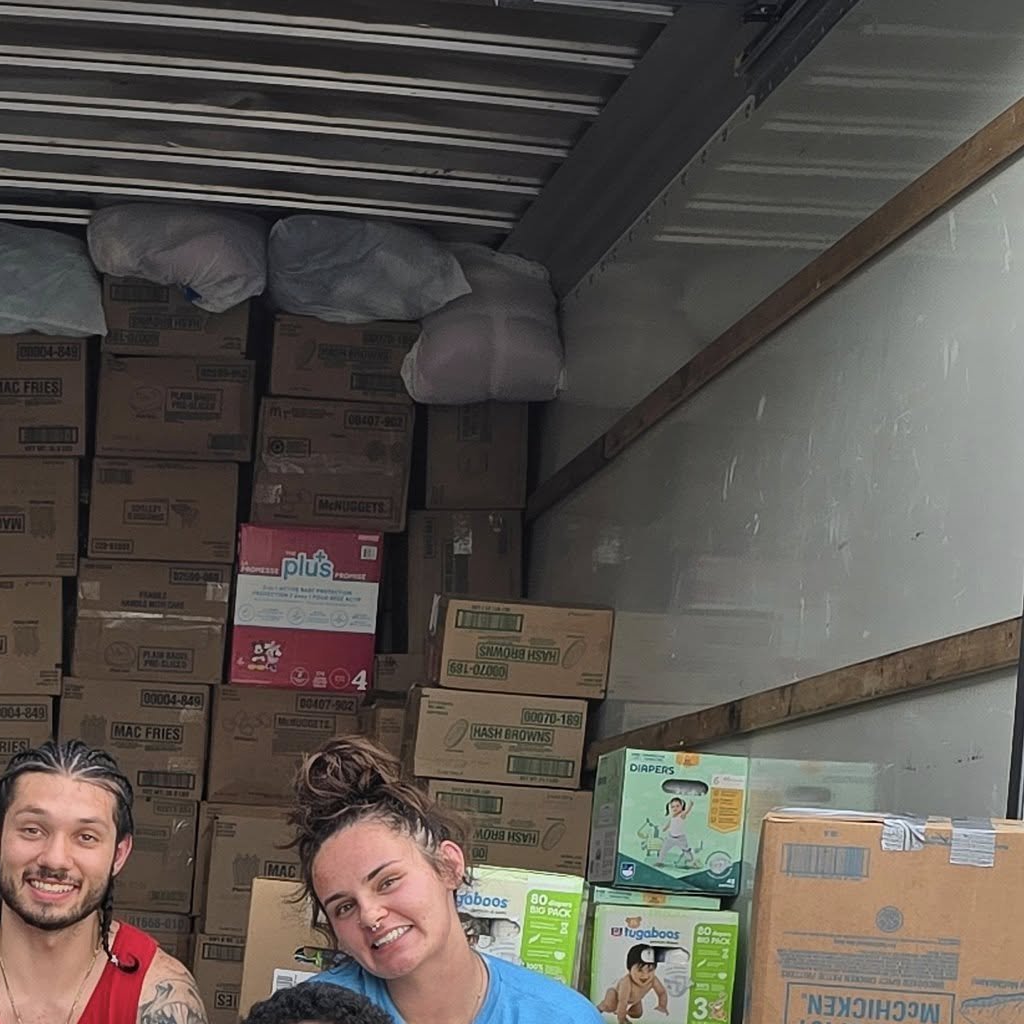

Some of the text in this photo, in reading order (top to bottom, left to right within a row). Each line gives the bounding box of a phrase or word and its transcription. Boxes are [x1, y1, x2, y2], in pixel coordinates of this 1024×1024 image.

[24, 381, 58, 394] FRIES
[283, 554, 332, 580] plus
[479, 645, 558, 662] HASH BROWNS
[351, 670, 368, 690] 4
[143, 692, 201, 707] 00004-849
[114, 725, 180, 741] MAC FRIES
[473, 726, 551, 743] HASH BROWNS
[630, 763, 675, 775] DIAPERS
[474, 828, 536, 843] HASH BROW
[268, 864, 296, 877] MAC
[457, 890, 509, 909] gaboos
[531, 894, 548, 905] 80
[530, 904, 572, 917] BIG PACK
[624, 926, 680, 941] tugaboos
[697, 935, 730, 946] BIG PACK
[217, 994, 239, 1007] IES
[693, 999, 709, 1020] 3
